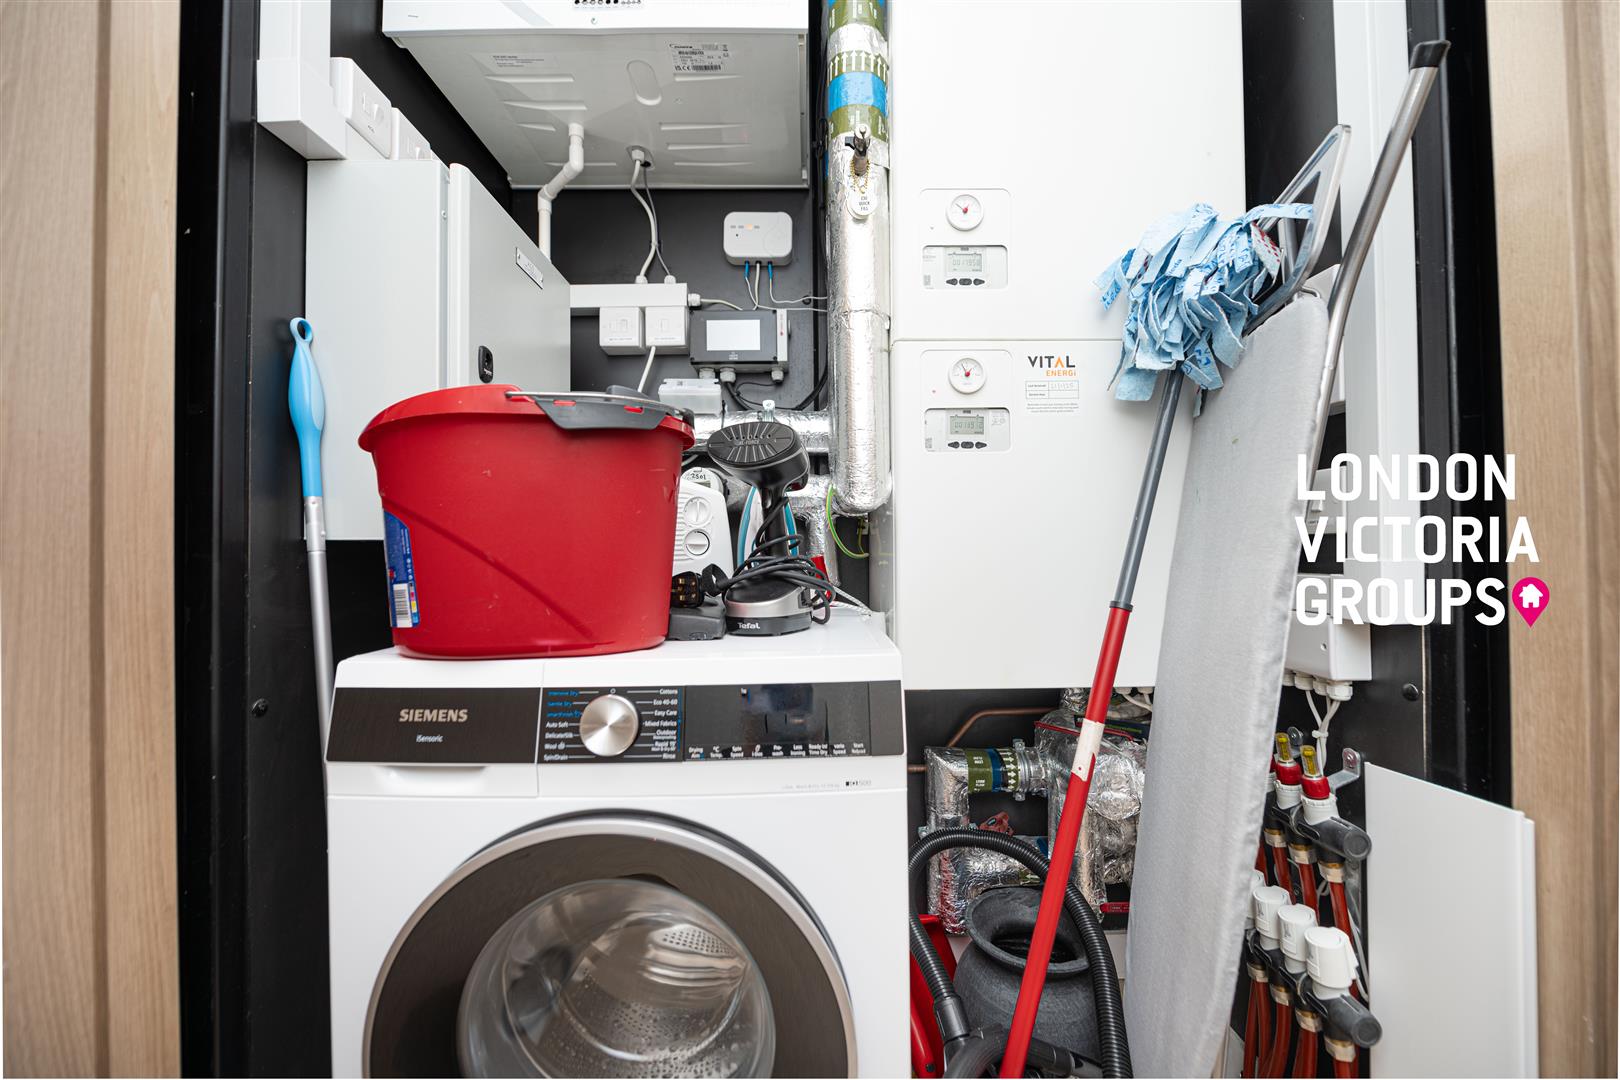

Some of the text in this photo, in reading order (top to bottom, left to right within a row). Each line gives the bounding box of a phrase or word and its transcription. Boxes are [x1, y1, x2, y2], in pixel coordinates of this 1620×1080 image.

[1027, 355, 1076, 368] VITAL
[1046, 369, 1077, 377] ENERGI
[737, 622, 761, 630] Tefal
[399, 709, 468, 722] SIEMENS
